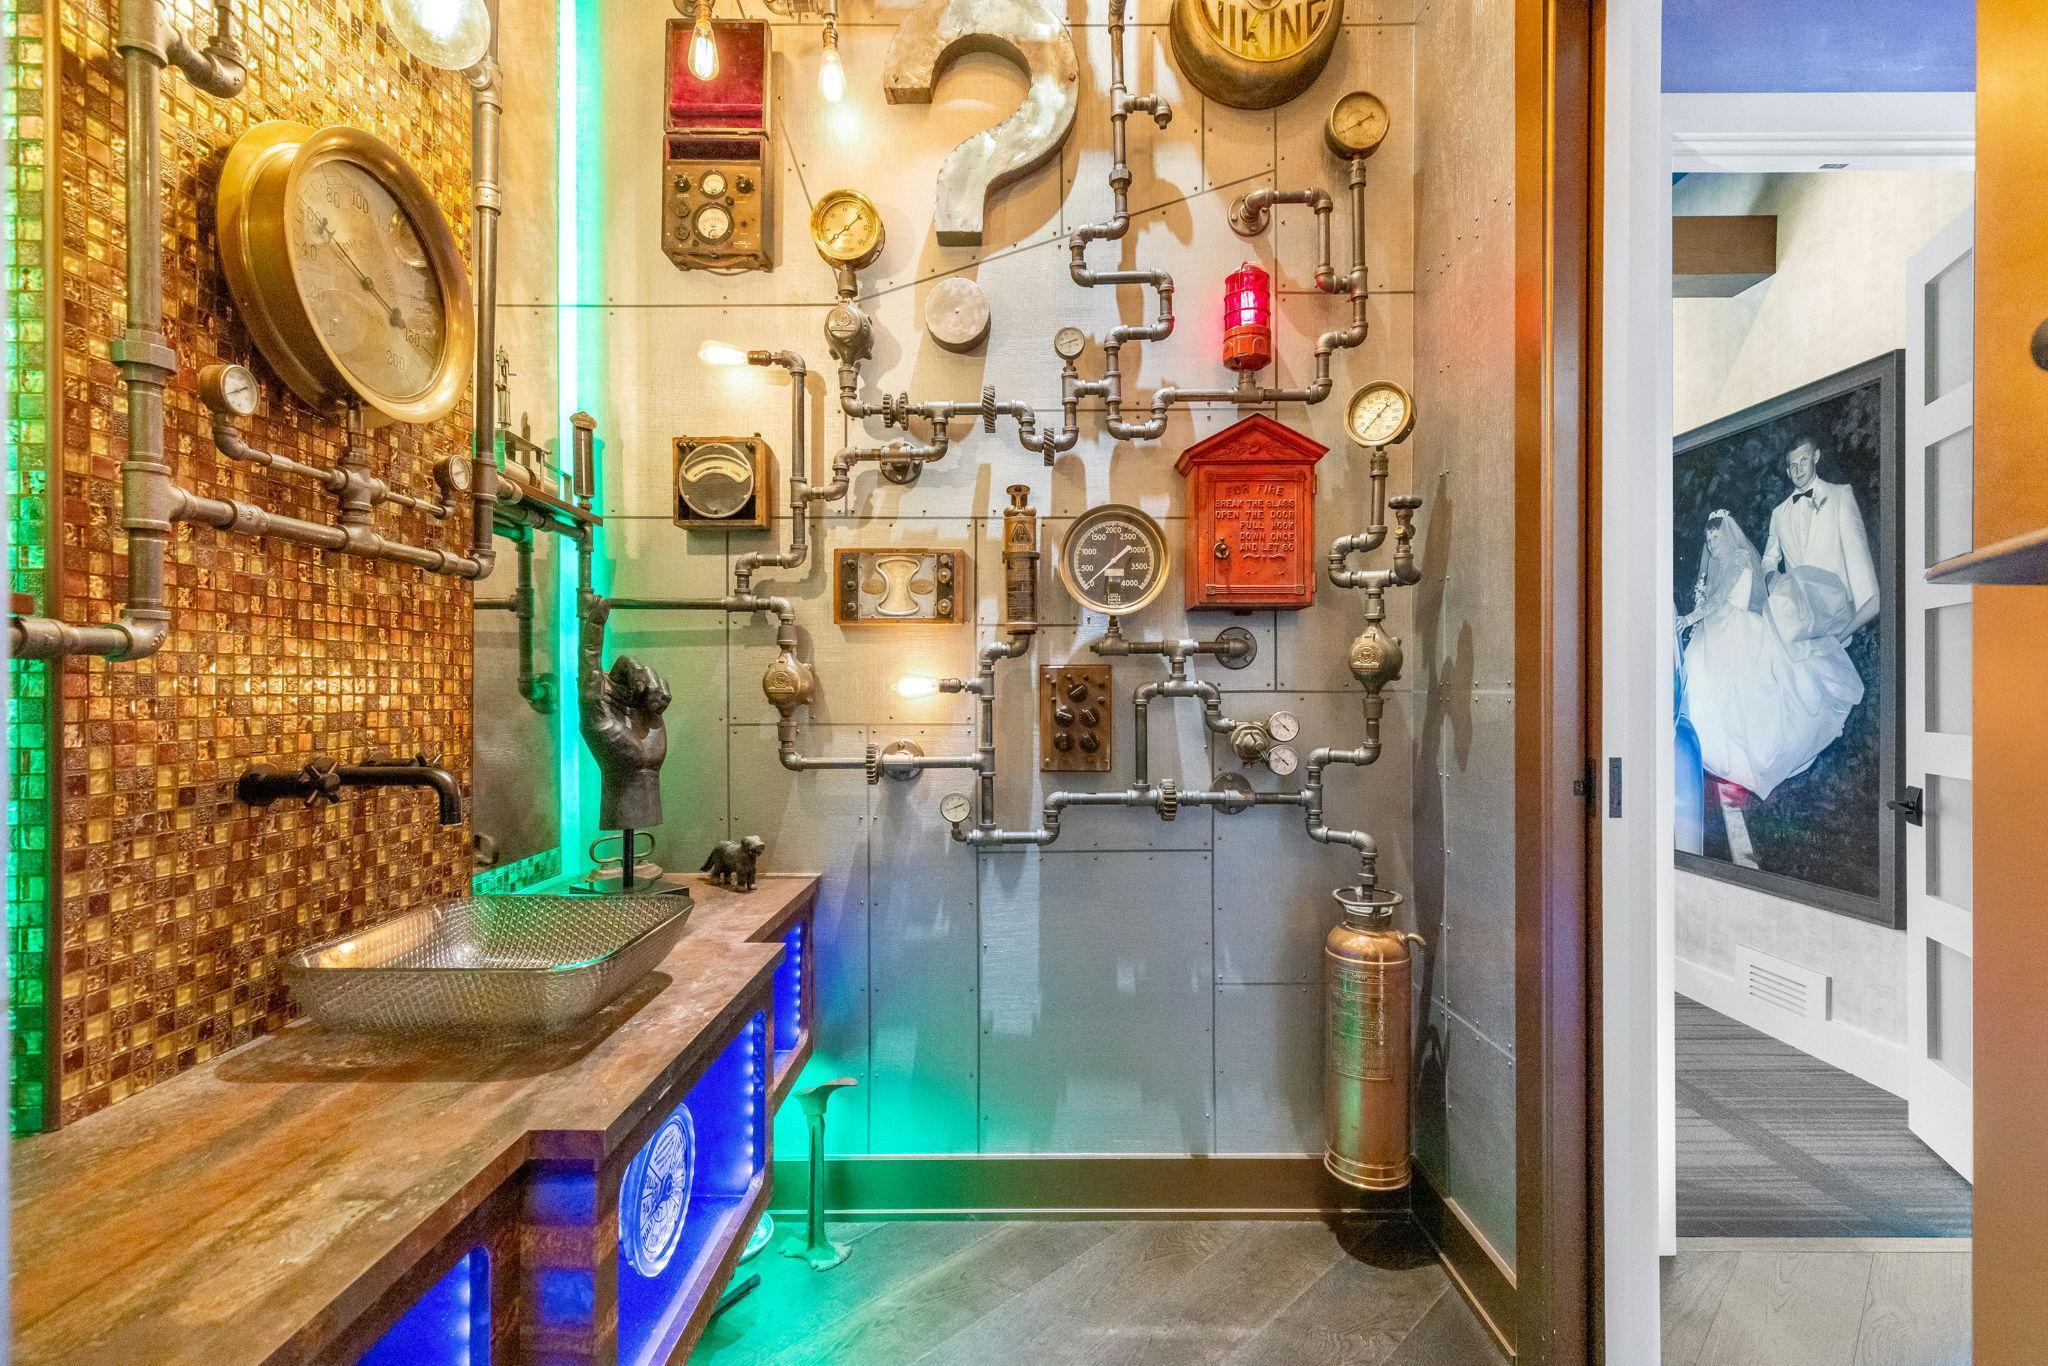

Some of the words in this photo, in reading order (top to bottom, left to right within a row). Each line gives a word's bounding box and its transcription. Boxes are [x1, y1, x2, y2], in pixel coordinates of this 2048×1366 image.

[352, 190, 369, 214] 100
[1257, 484, 1285, 496] FIRE
[1215, 499, 1244, 509] BREAK
[1246, 499, 1264, 509] THE
[1266, 499, 1295, 508] GLASS
[1215, 510, 1240, 520] OPEN
[1245, 510, 1264, 520] THE
[1270, 510, 1295, 519] DOOR
[1240, 521, 1264, 530] PULL
[1272, 521, 1295, 530] HOOK
[1240, 532, 1266, 541] DOWN
[1271, 532, 1295, 541] ONCE
[1240, 542, 1258, 552] AND
[1262, 543, 1279, 552] LET
